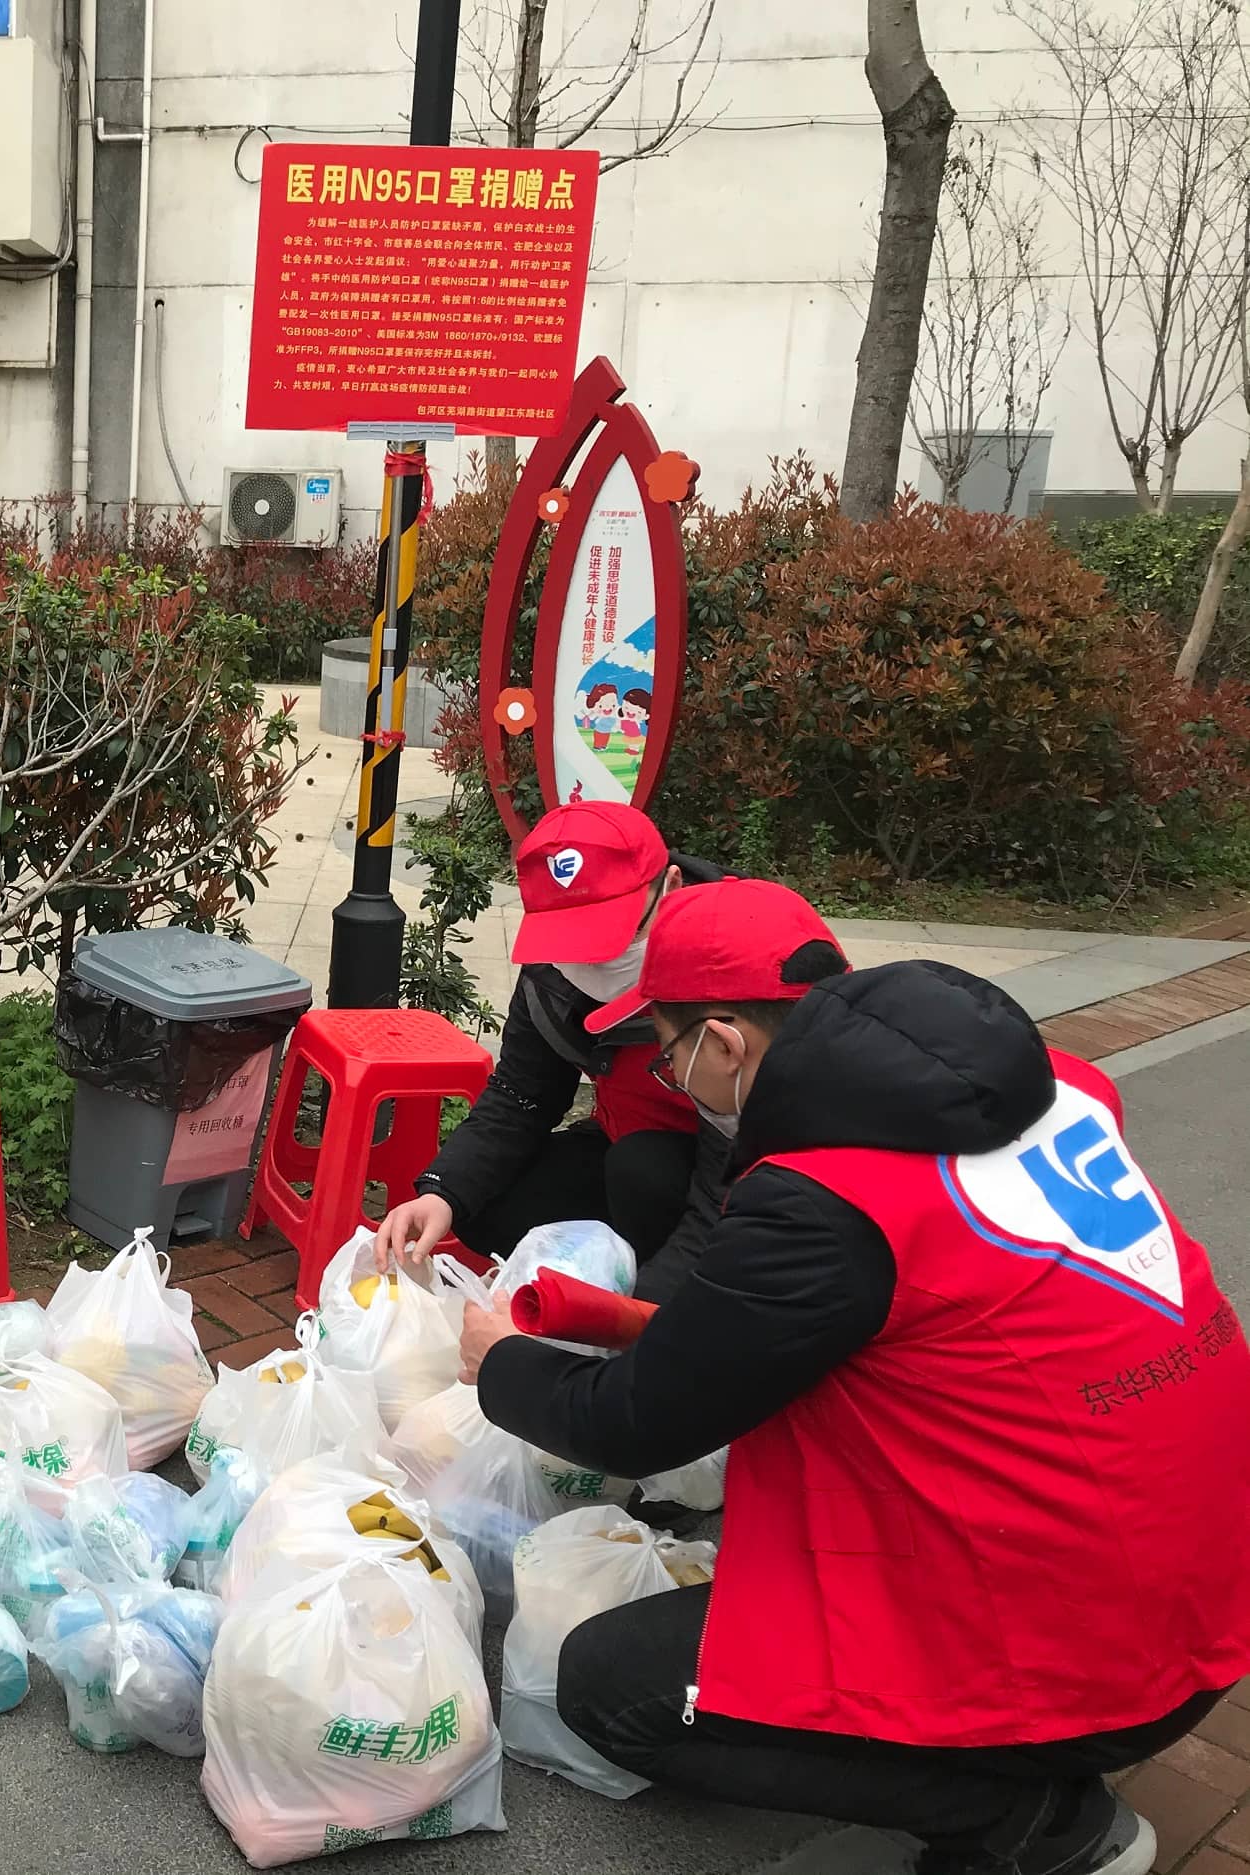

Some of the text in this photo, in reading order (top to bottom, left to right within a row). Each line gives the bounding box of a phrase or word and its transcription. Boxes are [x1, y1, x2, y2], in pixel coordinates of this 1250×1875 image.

[286, 163, 576, 210] 医用N95口罩捐赠点
[581, 545, 602, 665] 促进未成年人健康成长
[602, 545, 622, 643] 加强思想道德建设
[187, 1114, 244, 1135] 专用回收桶
[1127, 1236, 1171, 1274] (EC)
[318, 1694, 460, 1764] 鲜丰水果
